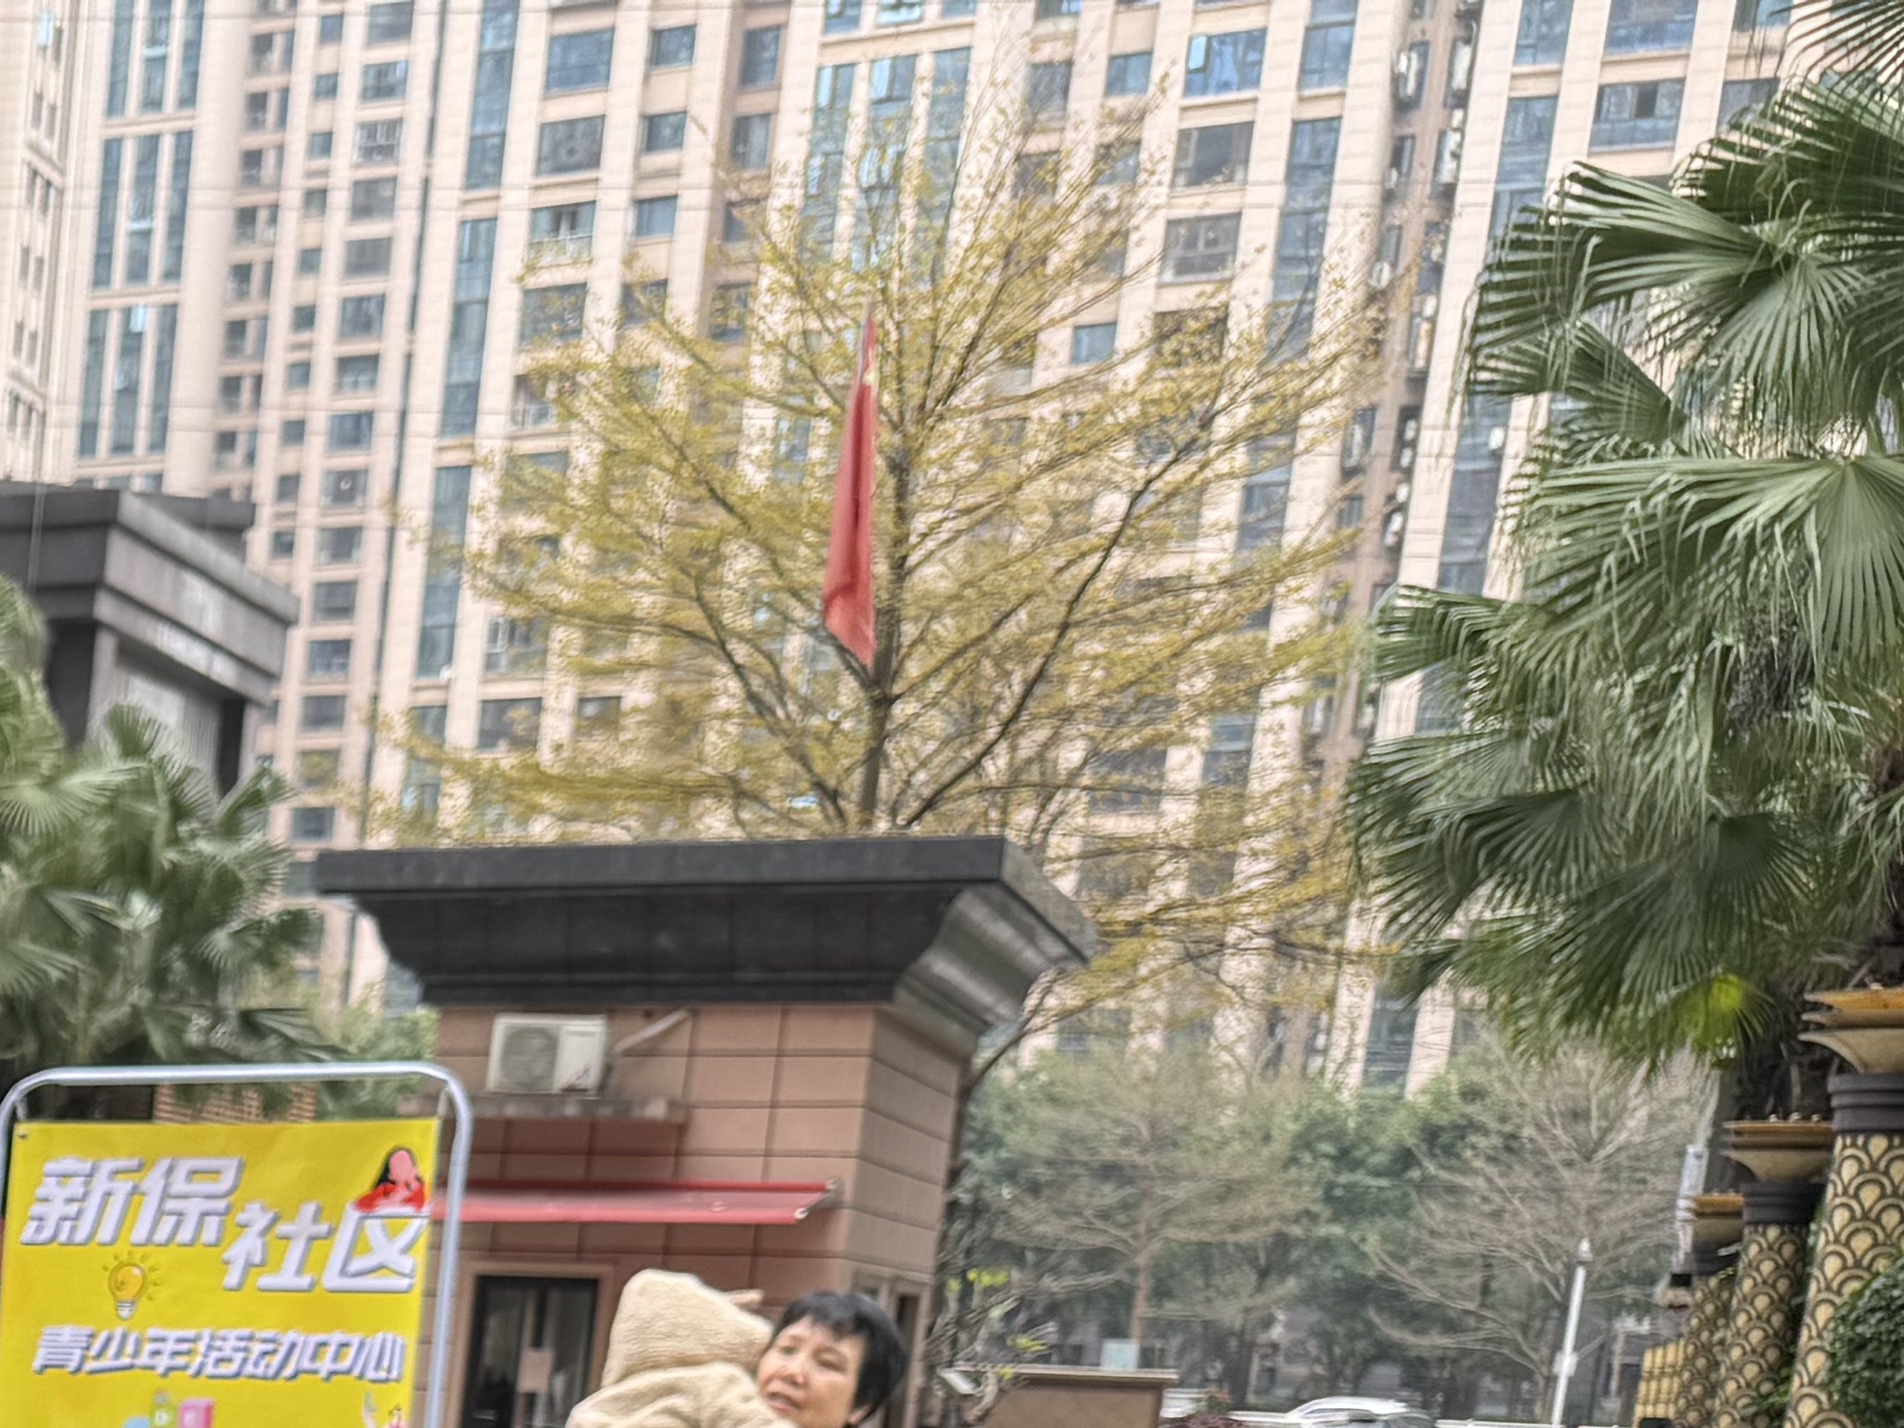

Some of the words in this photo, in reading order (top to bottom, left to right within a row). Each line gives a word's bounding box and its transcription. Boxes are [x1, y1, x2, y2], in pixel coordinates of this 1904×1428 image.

[19, 1155, 430, 1294] 新保社区
[32, 1324, 405, 1384] 青少年活动中心
